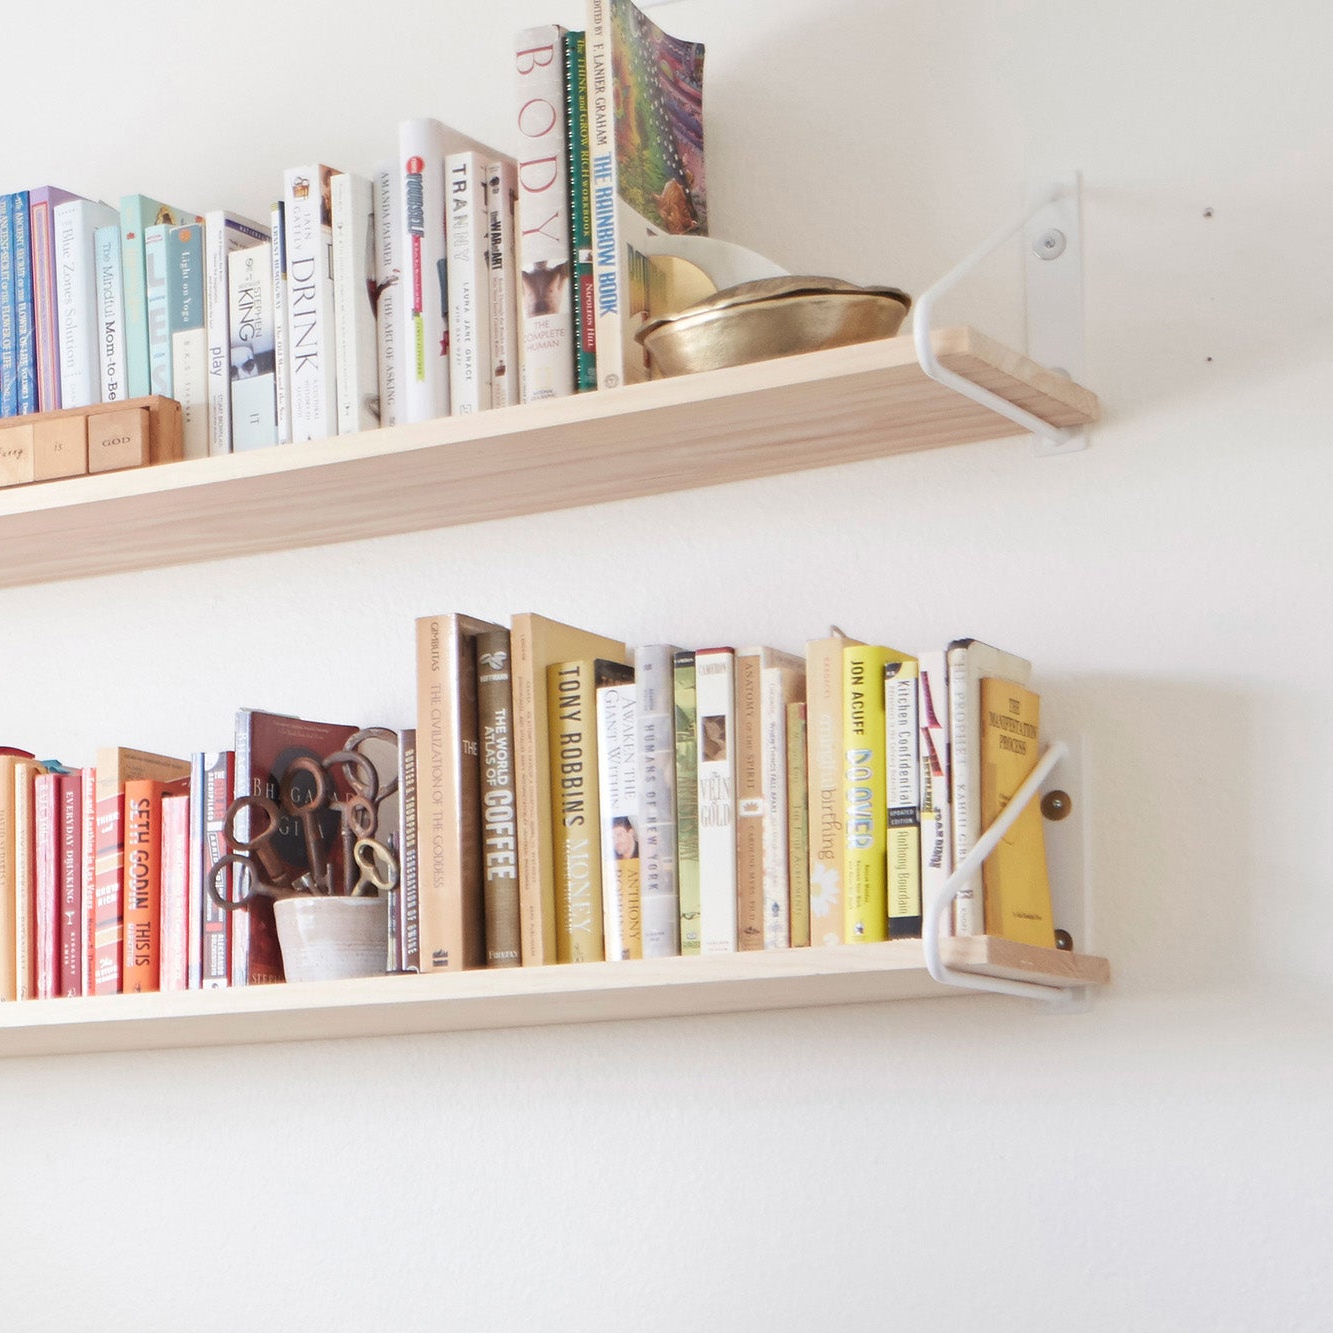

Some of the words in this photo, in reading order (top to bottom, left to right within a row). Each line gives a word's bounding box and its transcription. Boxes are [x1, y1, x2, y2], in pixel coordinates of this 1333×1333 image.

[516, 44, 560, 242] BODY
[594, 152, 613, 184] THE
[381, 171, 390, 219] AMANDA
[451, 163, 469, 262] TRANNY
[62, 229, 74, 261] Blue
[293, 206, 302, 251] GATELY
[304, 212, 312, 240] IAIN
[383, 222, 392, 267] PALMER
[594, 187, 617, 267] RAINBOW
[102, 243, 111, 264] The
[63, 264, 75, 305] Zones
[103, 266, 115, 322] Mindful
[273, 258, 281, 310] HEMINGWAY
[599, 273, 617, 318] BOOK
[238, 288, 255, 342] KING
[252, 284, 262, 338] STEPHEN
[291, 257, 319, 373] DRINK
[384, 296, 394, 320] THE
[533, 320, 550, 330] THE
[63, 309, 78, 368] Solution
[385, 324, 395, 346] ART
[386, 348, 396, 361] OF
[524, 329, 566, 344] COMPLETE
[525, 340, 560, 352] HUMAN
[105, 321, 117, 401] Mom-to-Be
[209, 346, 225, 377] play
[386, 363, 398, 406] ASKING
[249, 412, 259, 425] IT
[53, 441, 63, 453] is
[101, 434, 132, 448] GOD
[430, 621, 440, 672] GIMBUTAS
[698, 662, 728, 677] CAMERON
[851, 660, 865, 686] JON
[431, 684, 441, 706] THE
[558, 665, 580, 723] TONY
[851, 690, 865, 737] ACUFF
[897, 680, 910, 727] Kitchen
[1008, 698, 1020, 715] THE
[495, 708, 505, 733] THE
[604, 689, 619, 743] GIANT
[621, 697, 637, 762] AWAKEN
[988, 711, 1037, 739] MANIFESTATION
[431, 709, 443, 787] CIVILIZATION
[485, 726, 496, 765] ATLAS
[496, 737, 509, 785] WORLD
[644, 723, 656, 784] HUMANS
[846, 748, 873, 784] DO
[999, 734, 1027, 756] PROCESS
[485, 769, 497, 786] OF
[560, 732, 585, 829] ROBBINS
[607, 745, 620, 811] WITHIN
[624, 767, 637, 800] THE
[700, 776, 731, 798] VEIN
[897, 730, 911, 808] Confidential
[65, 791, 74, 848] EVERYDAY
[432, 790, 443, 806] OF
[645, 791, 657, 806] OF
[700, 802, 731, 828] GOLD
[846, 787, 874, 850] OVER
[129, 798, 150, 845] SETH
[433, 811, 443, 833] THE
[485, 789, 516, 881] COFFEE
[646, 810, 659, 846] NEW
[433, 836, 444, 888] GODDESS
[895, 831, 909, 870] Anthony
[66, 853, 75, 905] DRINKING
[128, 849, 150, 910] GODIN
[406, 849, 417, 909] GENERATION
[570, 837, 591, 934] MONEY
[646, 853, 660, 893] YORK
[897, 872, 909, 915] Bourdain
[407, 910, 417, 922] OF
[627, 868, 641, 942] ANTHONY
[136, 921, 150, 948] THIS
[407, 924, 417, 955] SWINE
[136, 953, 150, 966] IS
